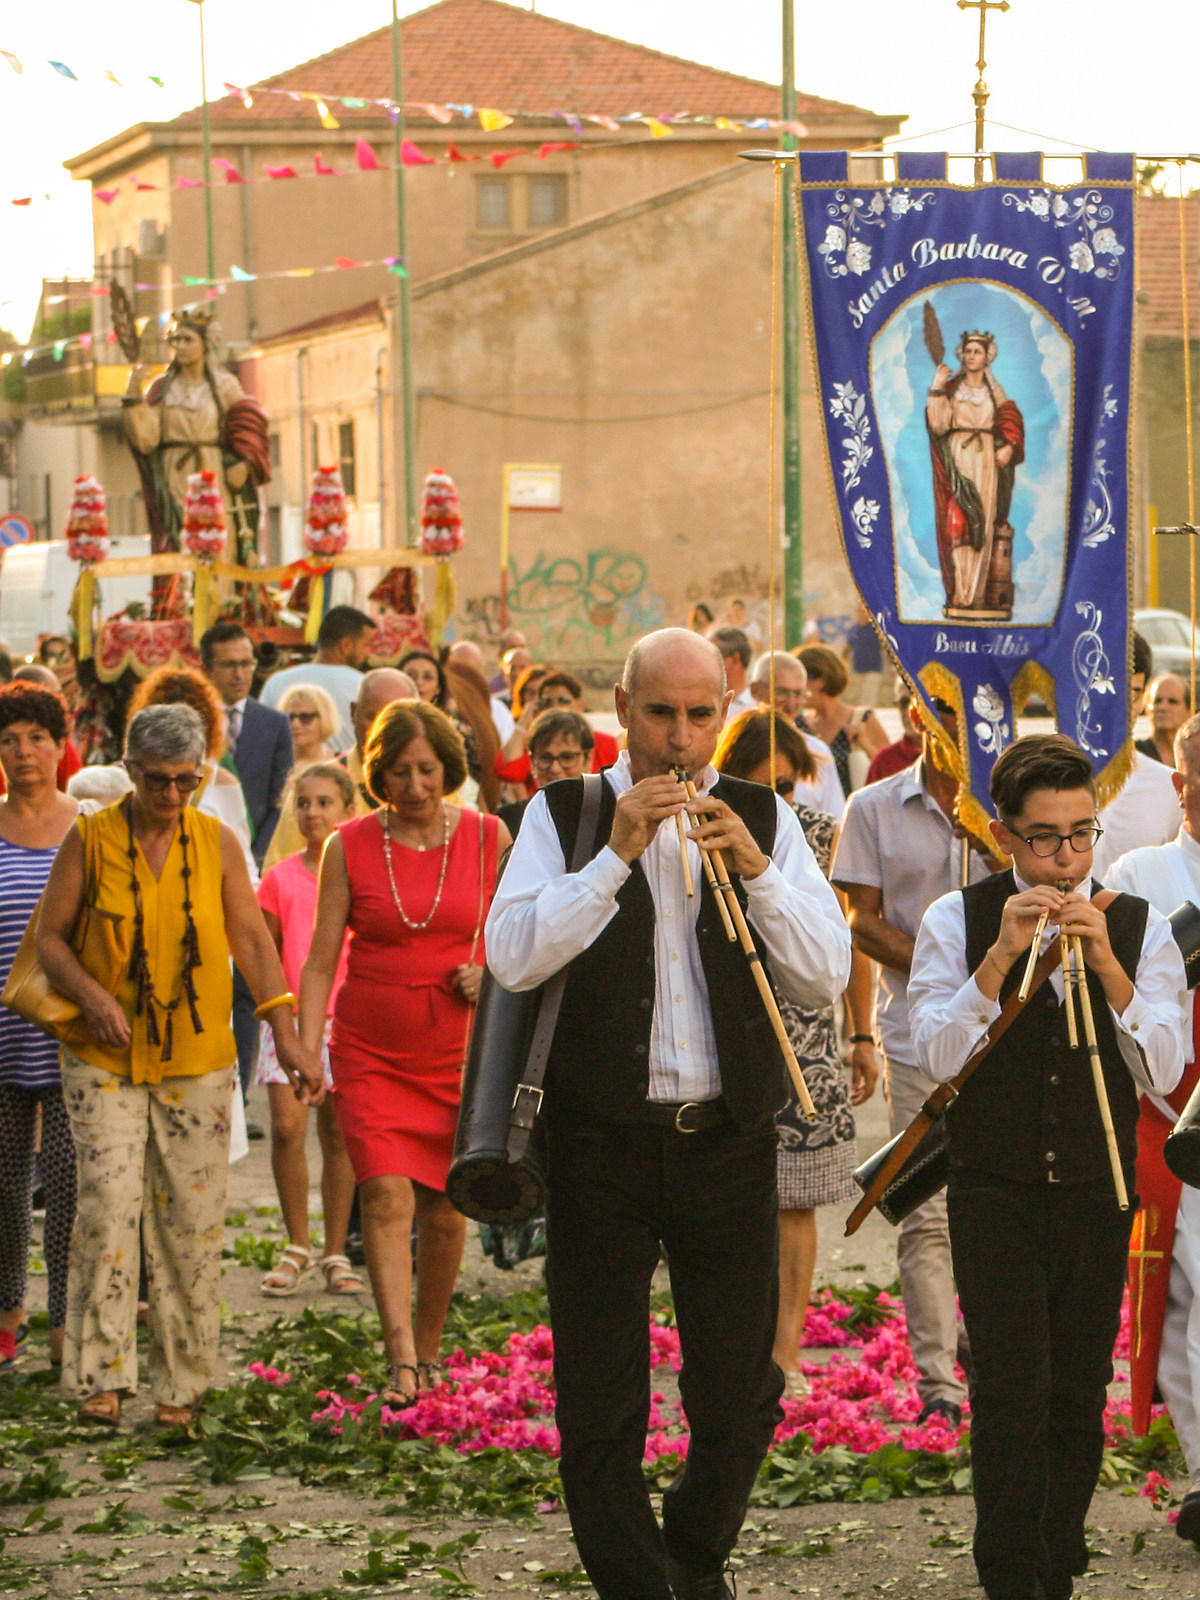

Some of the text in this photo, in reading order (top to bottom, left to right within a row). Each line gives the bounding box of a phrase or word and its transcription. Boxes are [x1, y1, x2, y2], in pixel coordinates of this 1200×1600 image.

[848, 262, 908, 329] Santa
[911, 234, 1028, 269] Barbara
[981, 634, 1029, 655] Abis
